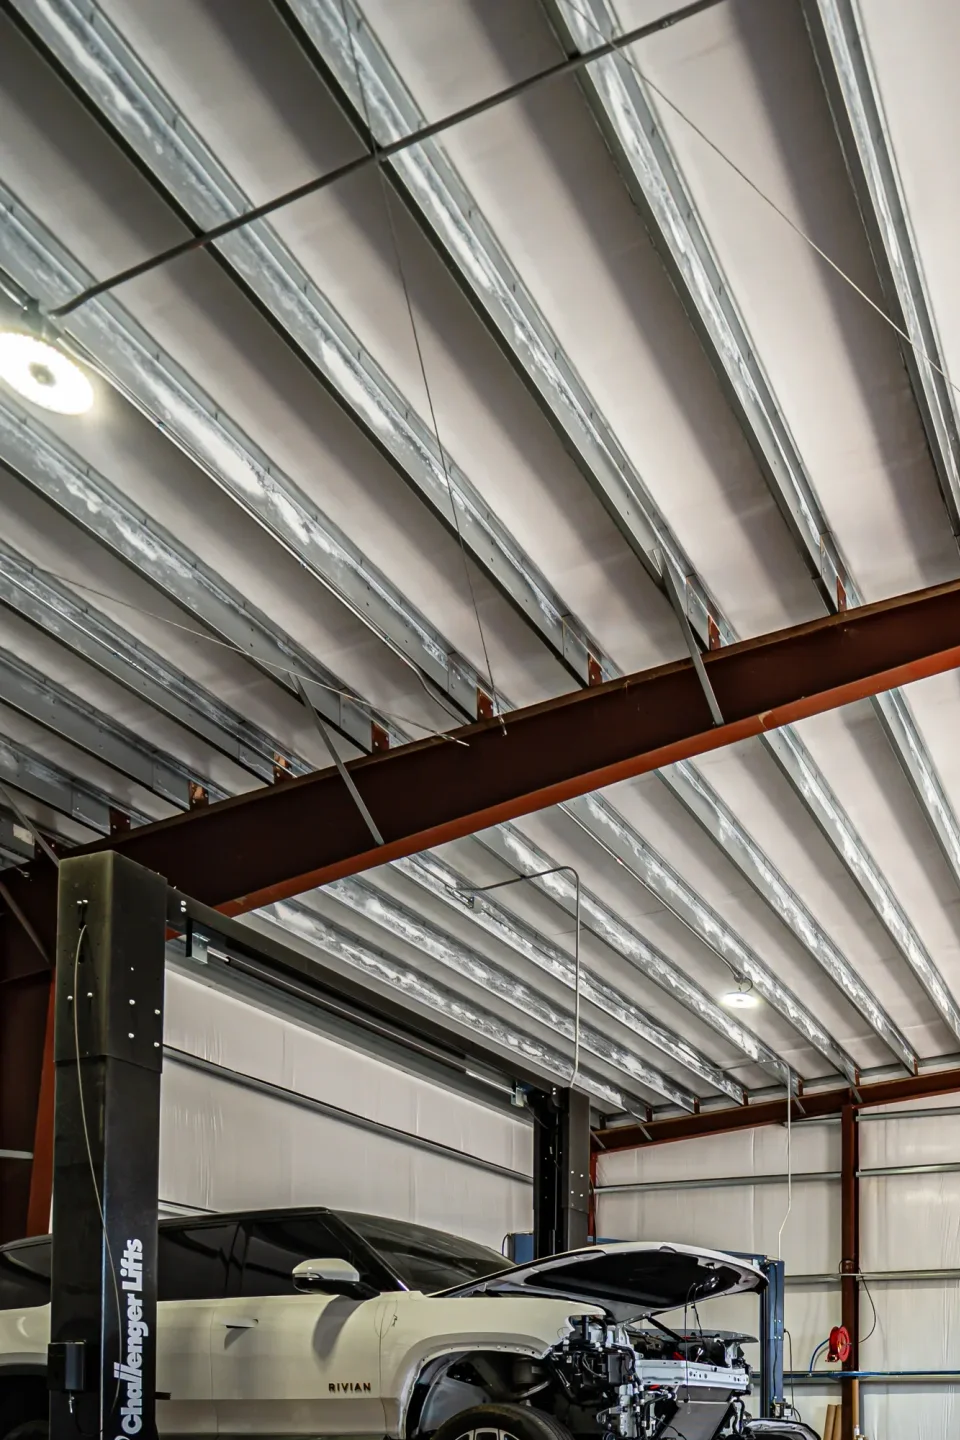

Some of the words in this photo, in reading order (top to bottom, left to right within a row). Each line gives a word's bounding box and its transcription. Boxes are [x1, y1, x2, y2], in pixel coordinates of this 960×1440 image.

[120, 1238, 143, 1292] Lifts
[113, 1292, 149, 1435] Challenger
[328, 1382, 372, 1392] RIVIAN
